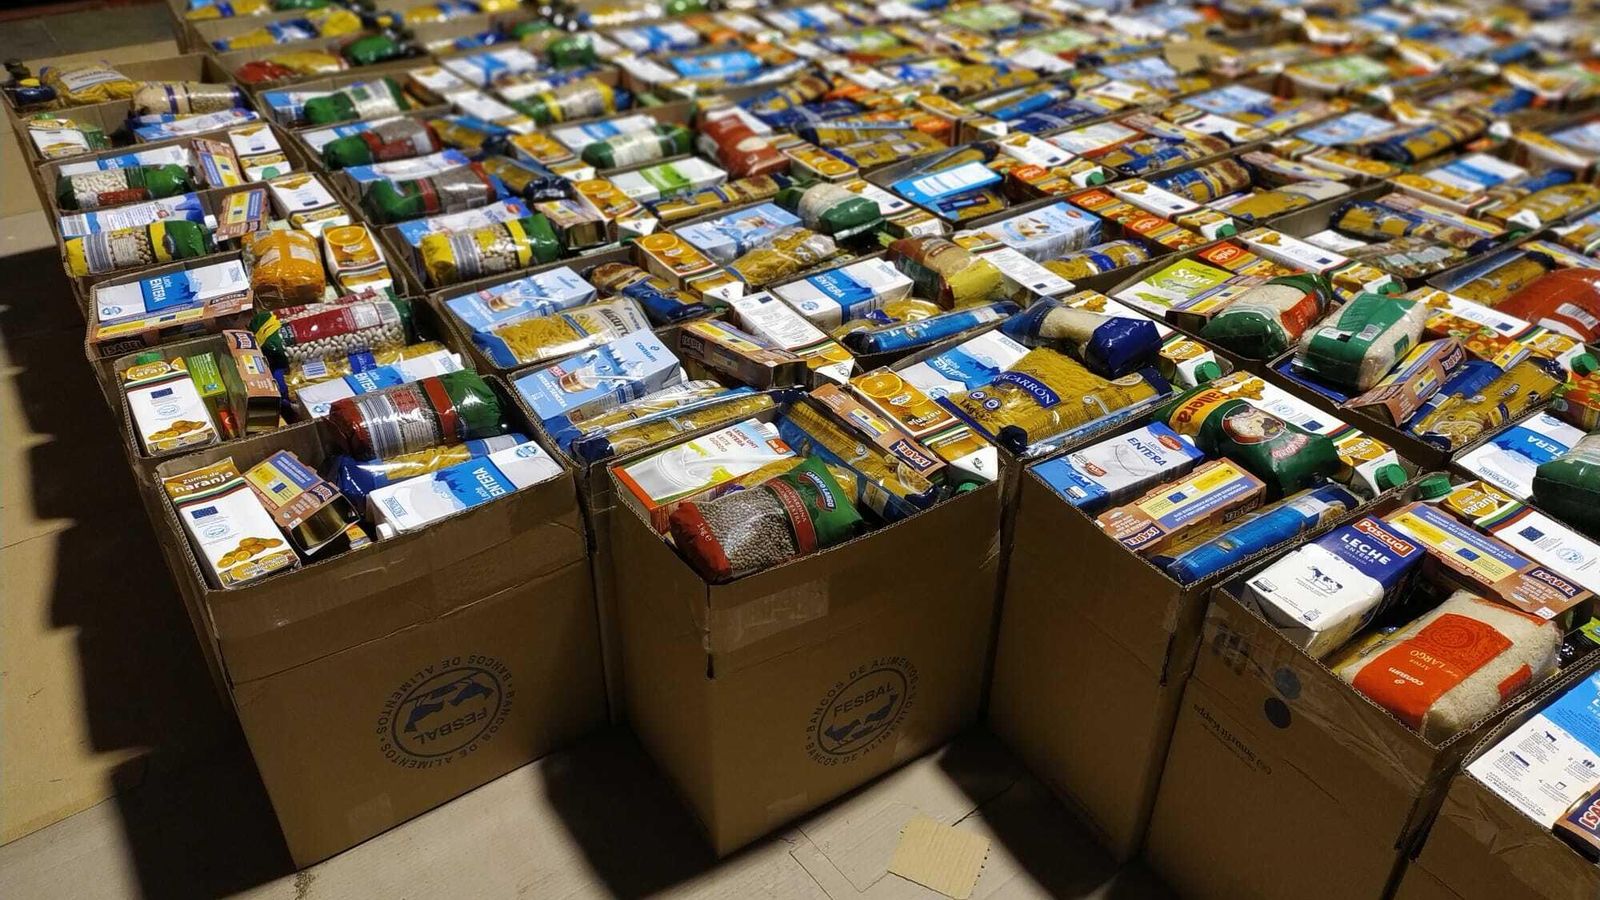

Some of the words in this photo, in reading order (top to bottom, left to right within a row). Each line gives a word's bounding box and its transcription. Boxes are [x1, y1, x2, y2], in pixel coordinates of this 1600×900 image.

[635, 340, 658, 363] consum
[897, 442, 933, 468] ISABEL
[1126, 437, 1169, 468] ENTERA
[173, 470, 235, 494] naranja
[182, 473, 209, 485] Zumo
[806, 471, 827, 492] CAMPO
[821, 487, 836, 509] LARGO
[1463, 491, 1503, 515] naranja
[1122, 525, 1160, 547] ISABEL
[1341, 533, 1392, 566] LECHE
[1359, 520, 1410, 557] Pascual
[1344, 545, 1375, 564] ENTERA
[1532, 569, 1577, 597] ISABEL
[441, 656, 462, 670] DE
[467, 654, 513, 683] BANCOS
[1410, 649, 1447, 670] LARGO
[1388, 666, 1425, 687] consum
[376, 664, 435, 735] ALIMENTOS
[805, 681, 844, 733] BANCOS
[849, 664, 866, 680] DE
[833, 681, 895, 718] FESBAL
[412, 706, 488, 745] FESBAL
[1192, 703, 1222, 732] Kappa
[380, 743, 454, 770] ALIMENTOS
[459, 742, 479, 759] DE
[805, 741, 839, 767] BANCOS
[842, 753, 859, 765] DE
[1219, 727, 1257, 762] Smurfit
